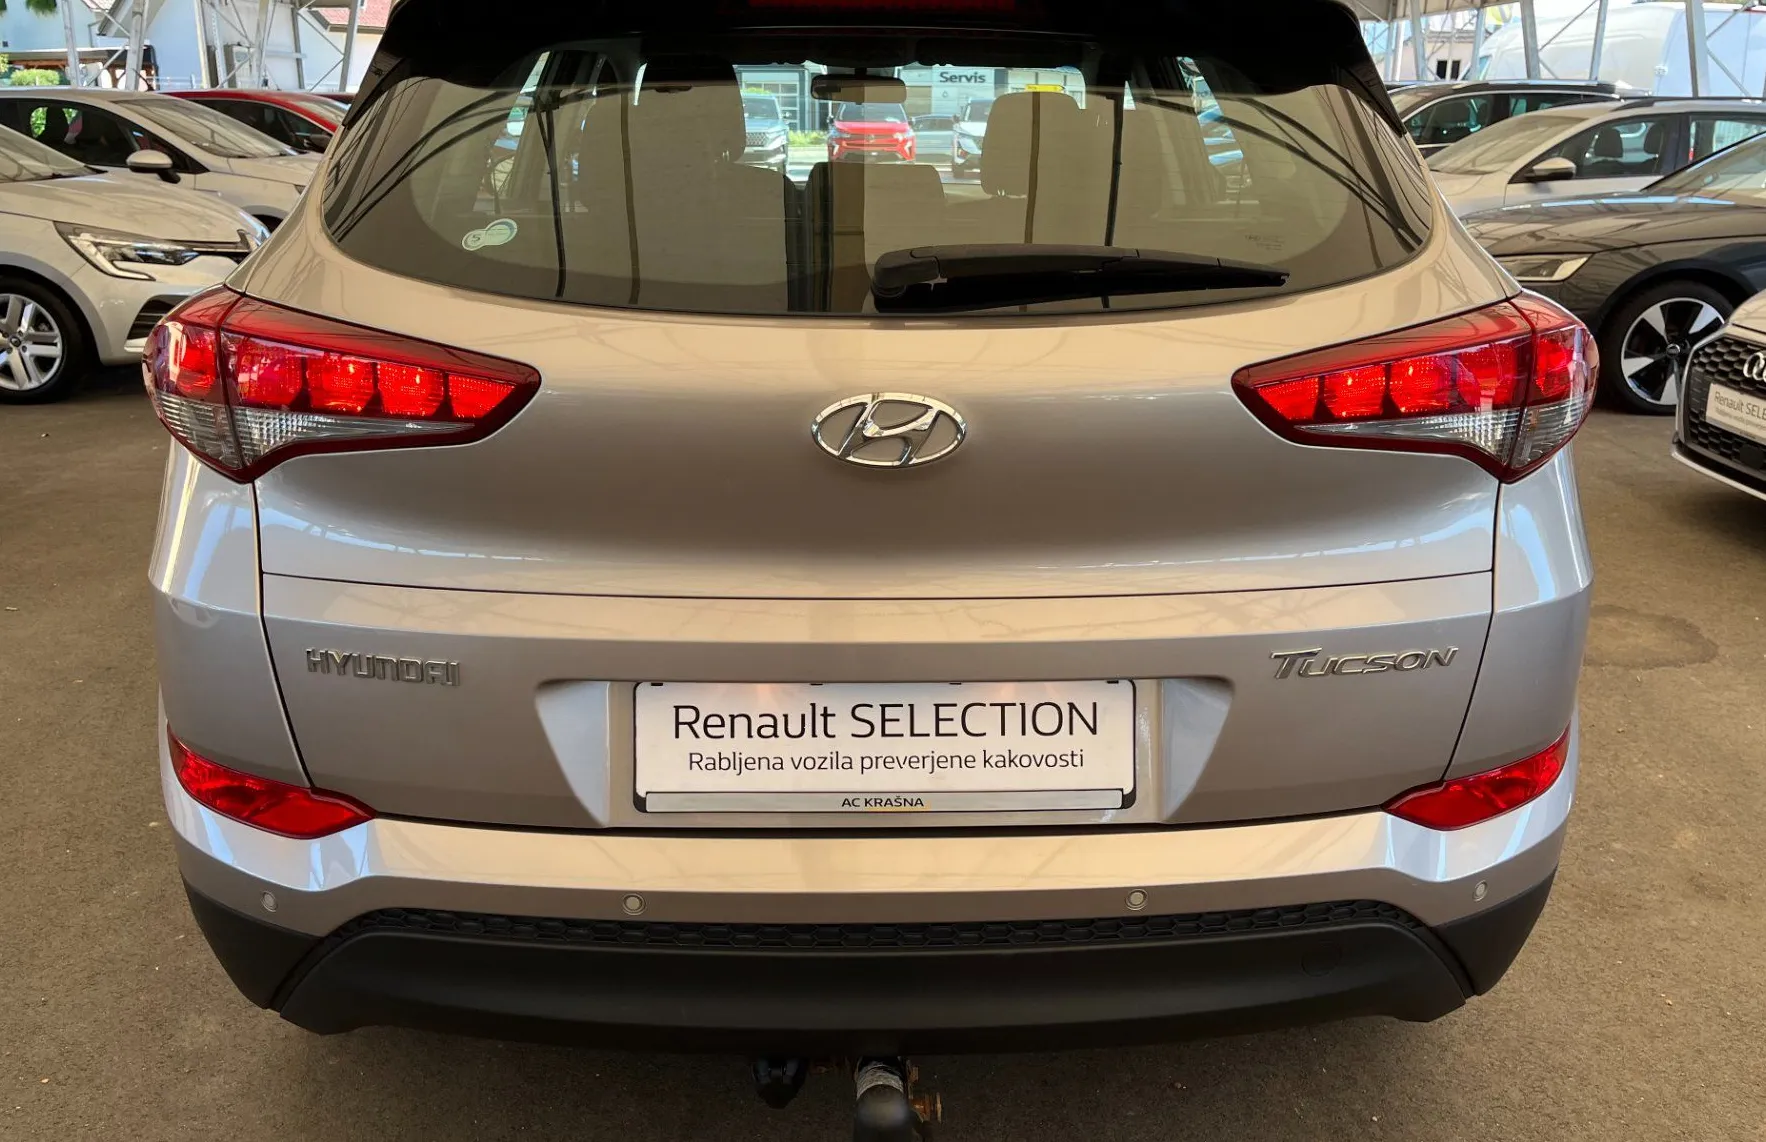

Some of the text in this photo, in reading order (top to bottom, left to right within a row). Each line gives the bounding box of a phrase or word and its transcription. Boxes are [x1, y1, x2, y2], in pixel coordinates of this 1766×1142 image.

[939, 71, 986, 83] Servis
[1714, 390, 1744, 413] Renault
[306, 647, 460, 686] HYUNDAI
[673, 701, 1097, 739] Renault SELECTION
[688, 748, 1084, 776] Rabljena vozila preverjene kakovosti
[841, 795, 924, 807] AC KRAŠNA
